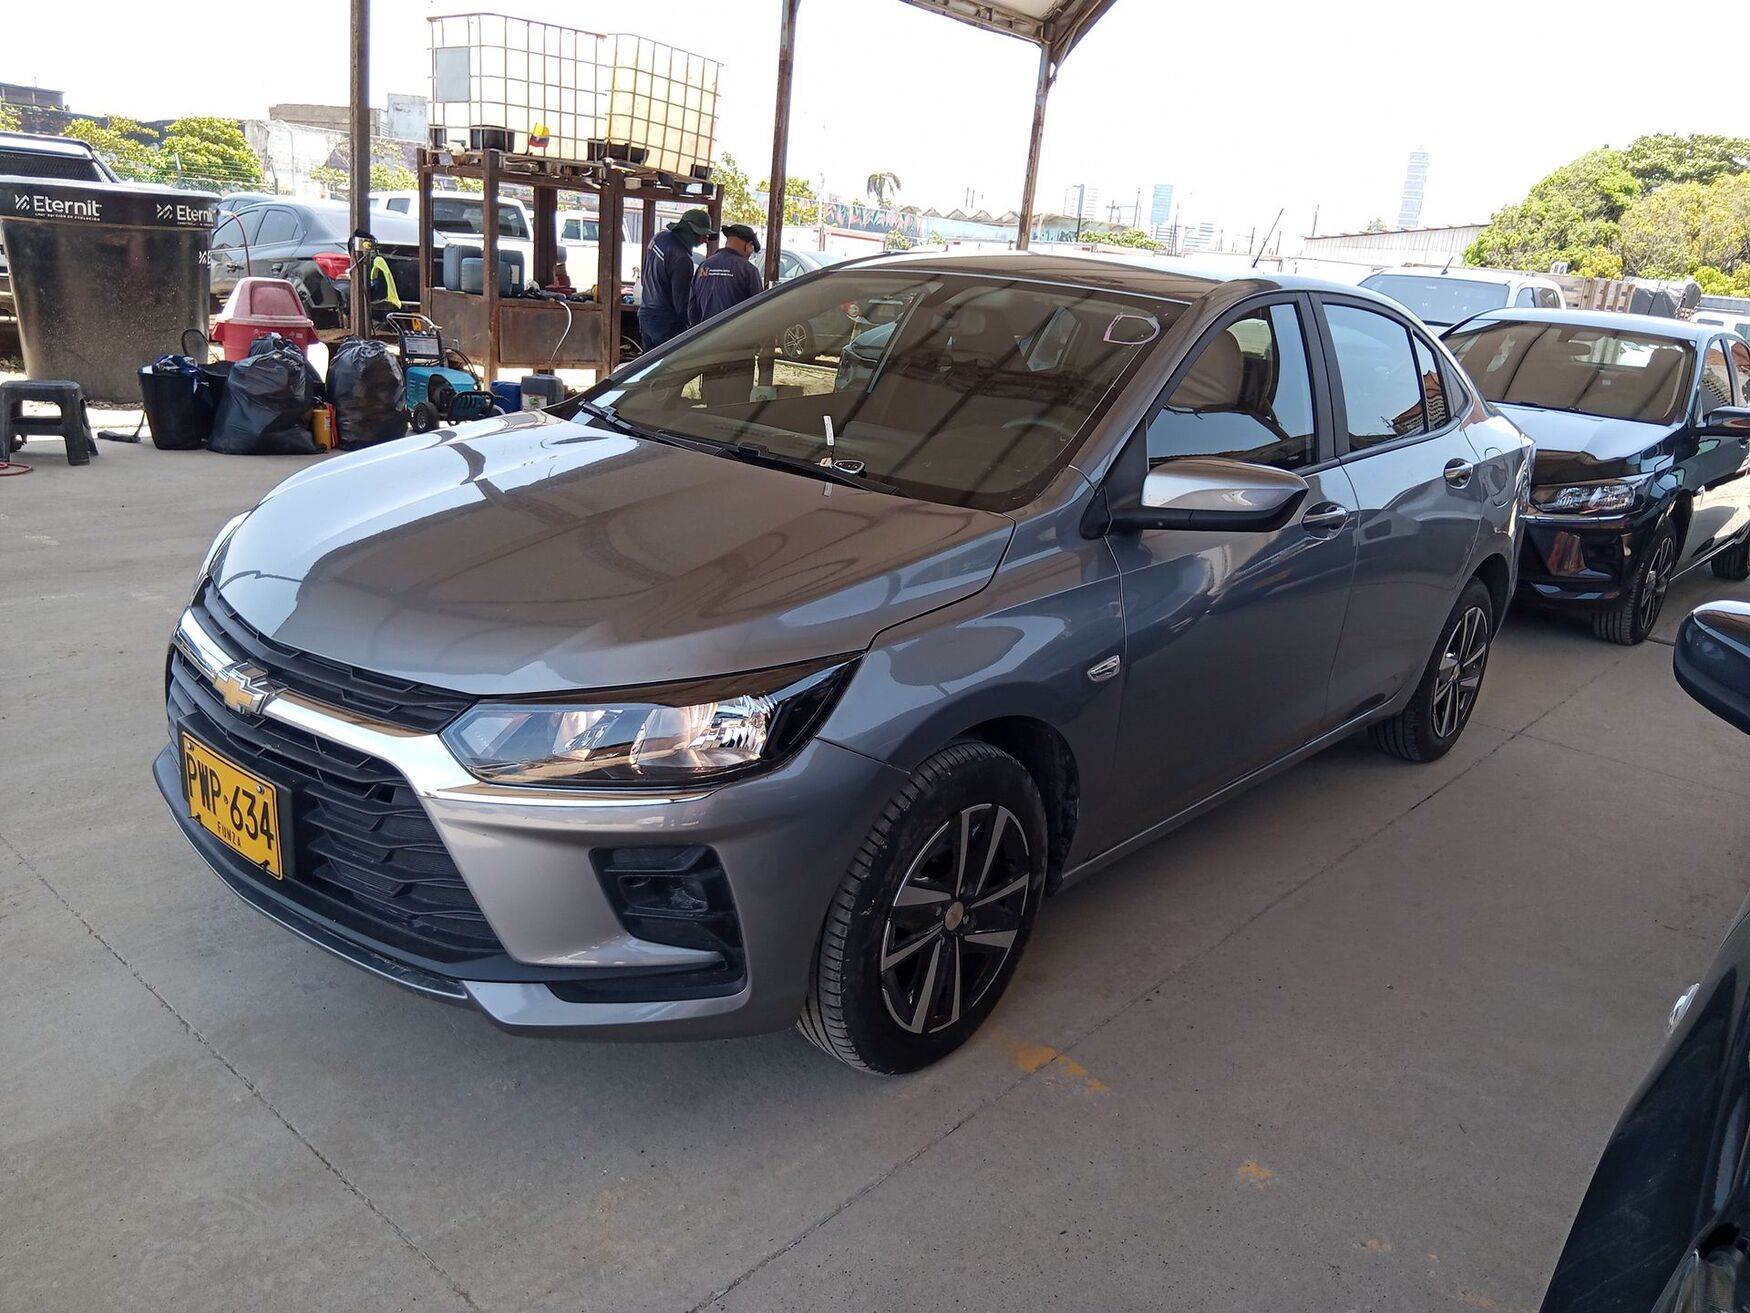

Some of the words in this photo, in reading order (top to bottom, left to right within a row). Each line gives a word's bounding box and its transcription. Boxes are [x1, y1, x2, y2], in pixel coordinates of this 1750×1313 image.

[33, 195, 102, 217] Eternit
[186, 752, 221, 815] PWP
[230, 786, 274, 850] 634
[217, 821, 242, 847] FUNZA
